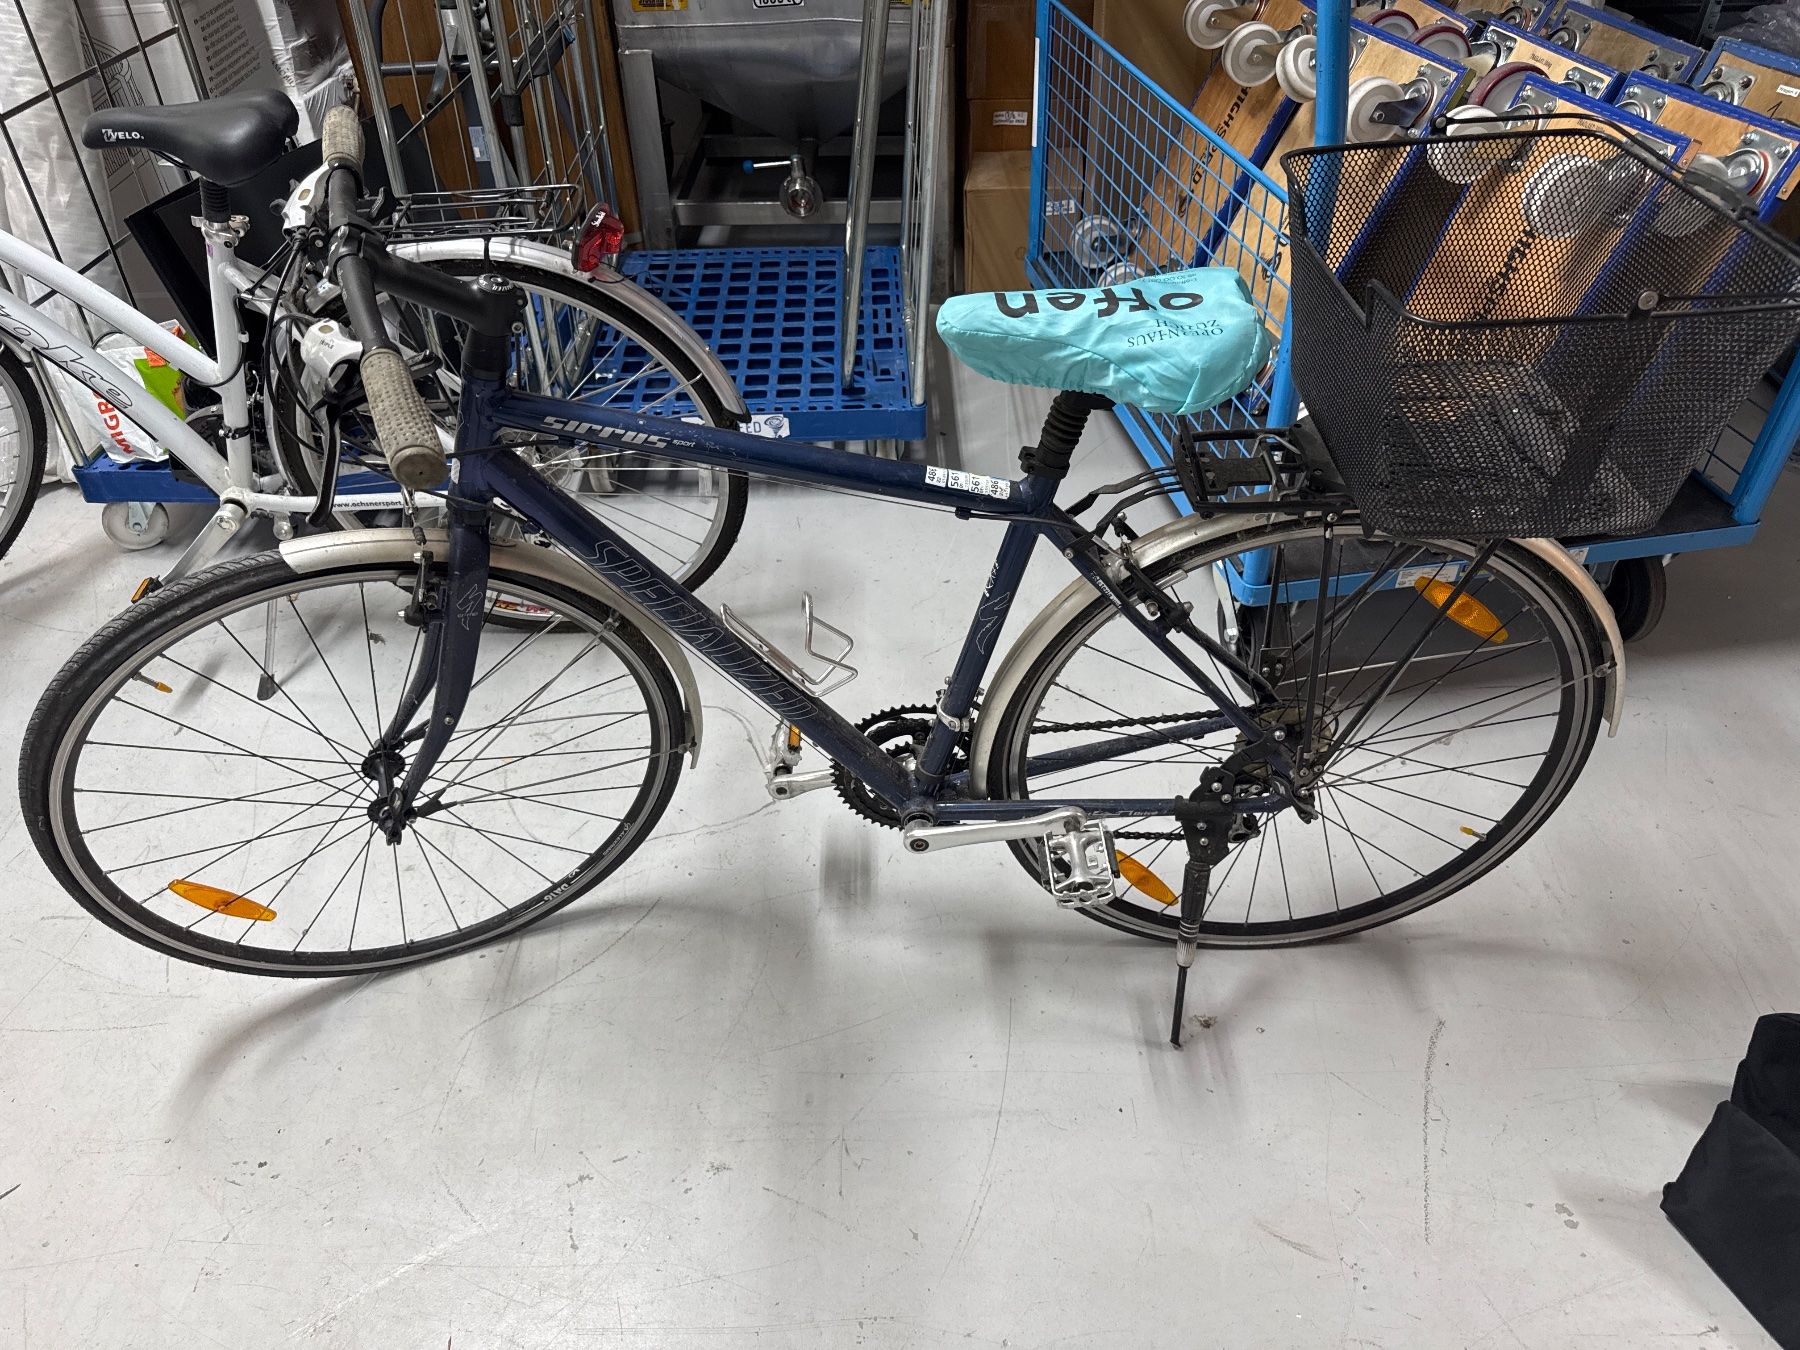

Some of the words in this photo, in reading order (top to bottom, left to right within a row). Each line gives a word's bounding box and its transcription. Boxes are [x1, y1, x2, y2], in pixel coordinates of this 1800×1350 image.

[994, 287, 1204, 319] offen
[1156, 318, 1220, 330] ZRIH
[672, 439, 696, 448] sport
[971, 476, 981, 493] 561
[569, 540, 819, 720] SPECIALIZED
